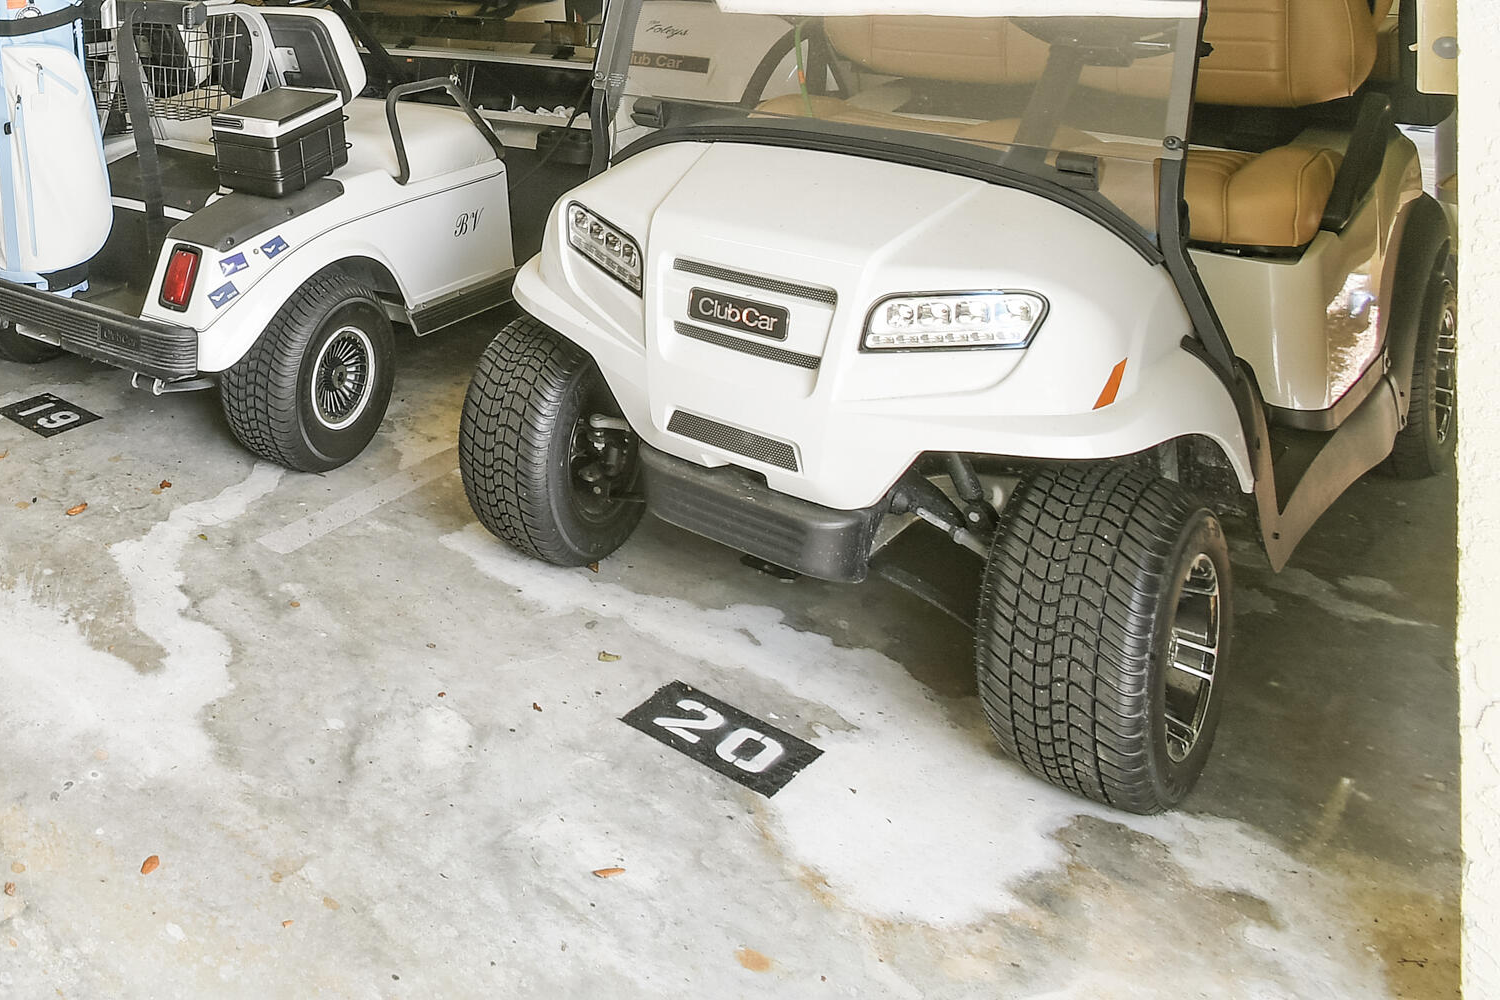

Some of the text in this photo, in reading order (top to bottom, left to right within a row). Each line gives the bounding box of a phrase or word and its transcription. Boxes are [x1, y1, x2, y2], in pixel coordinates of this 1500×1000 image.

[655, 55, 684, 69] Car
[18, 402, 81, 429] 19
[652, 699, 784, 773] 20
